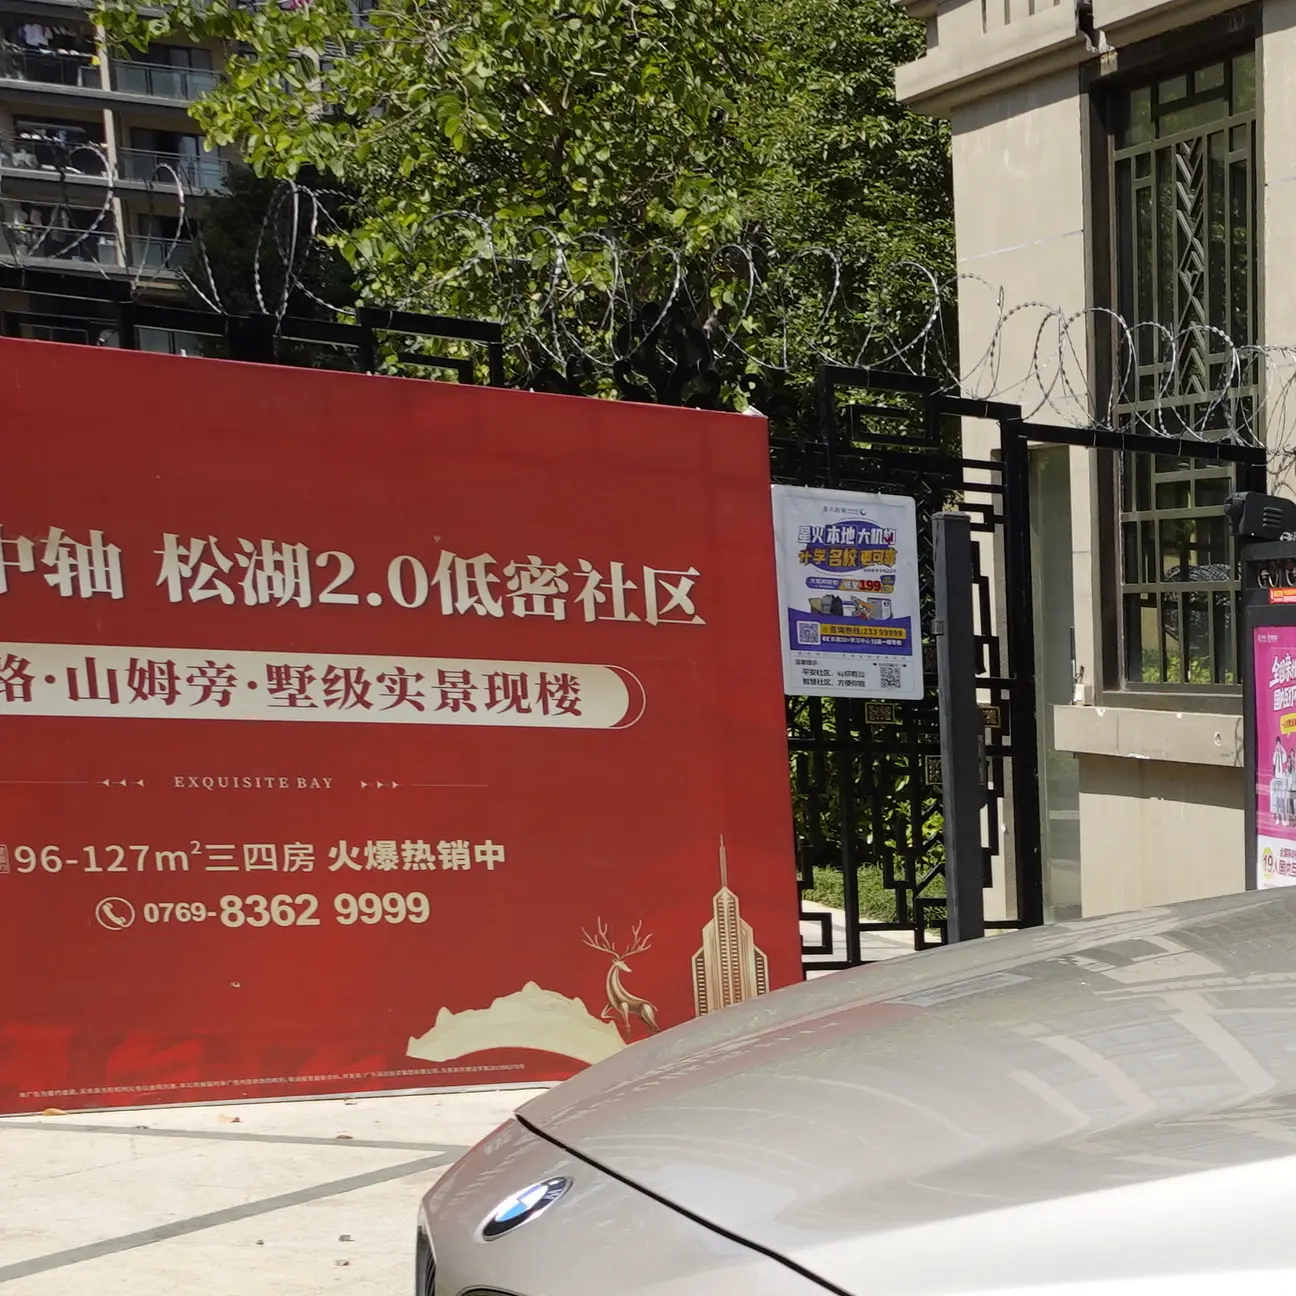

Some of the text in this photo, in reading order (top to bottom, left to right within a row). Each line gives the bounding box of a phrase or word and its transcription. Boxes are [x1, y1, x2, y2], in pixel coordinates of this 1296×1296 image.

[153, 531, 707, 627] 松湖2.0低密社区
[174, 776, 333, 791] EXQUISITE BAY
[328, 839, 506, 872] 火爆热销中
[334, 892, 431, 925] 9999
